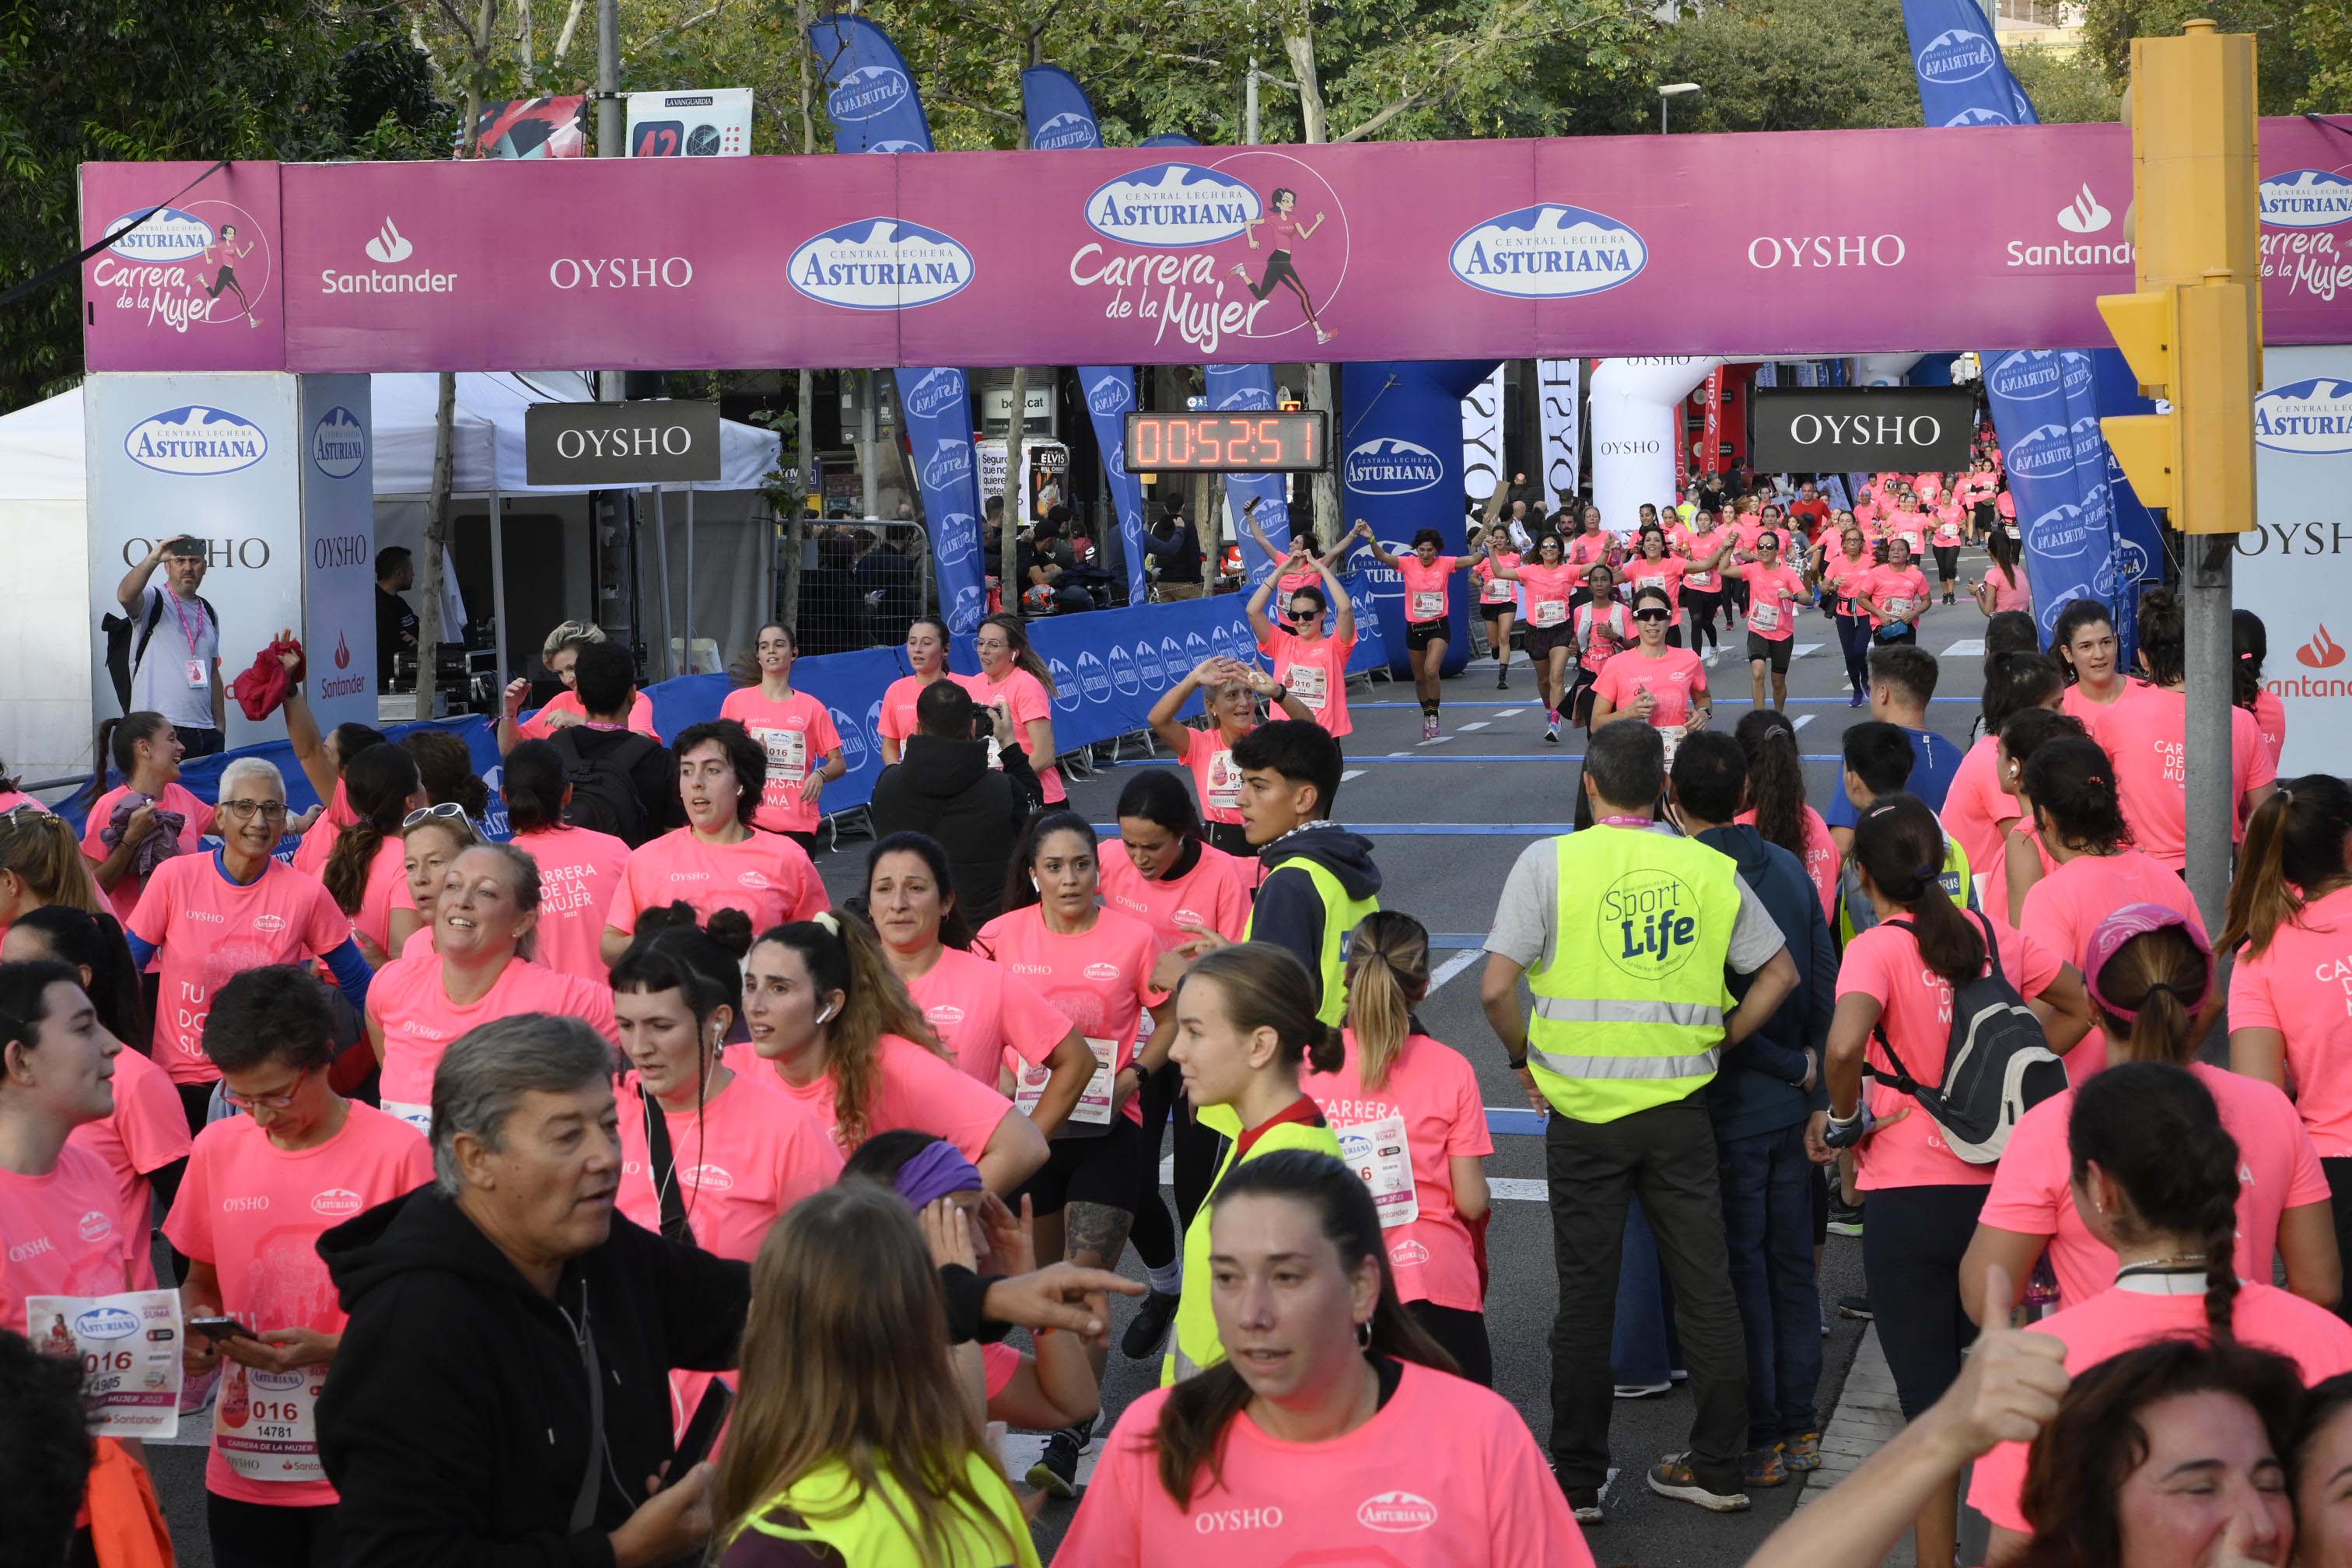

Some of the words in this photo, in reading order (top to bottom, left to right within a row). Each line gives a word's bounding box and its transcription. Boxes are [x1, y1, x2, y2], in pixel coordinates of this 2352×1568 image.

[1125, 192, 1181, 201] CENTRAL
[1187, 191, 1244, 200] LECHERA
[1099, 195, 1248, 227] ASTURIANA
[1496, 236, 1556, 246] CENTRAL
[1563, 236, 1626, 245] LECHERA
[1748, 234, 1906, 268] OYSHO
[2260, 232, 2334, 254] arrera
[830, 250, 888, 259] CENTRAL
[895, 249, 954, 258] LECHERA
[1465, 240, 1633, 275] ASTURIANA
[2007, 240, 2135, 268] Santand
[93, 258, 186, 287] Carrera
[549, 257, 694, 289] OYSHO
[802, 252, 961, 286] ASTURIANA
[1069, 243, 1216, 286] Carrera
[2278, 255, 2292, 277] la
[322, 269, 458, 294] Santander
[117, 289, 133, 309] de
[138, 289, 150, 309] la
[148, 285, 221, 333] Mujer
[1105, 288, 1132, 318] de
[1139, 287, 1158, 318] la
[1154, 280, 1270, 354] Mujer
[1002, 397, 1043, 409] bc.cat
[1790, 415, 1941, 446] OYSHO
[136, 432, 257, 458] ASTURIANA
[317, 432, 362, 462] ASTURIANA
[556, 425, 692, 459] OYSHO
[1137, 420, 1311, 464] 00:52:51
[1601, 440, 1660, 456] OYSHO
[1041, 453, 1065, 464] ELVIS
[1348, 461, 1436, 483] ASTURIANA
[123, 537, 271, 569] OHO
[314, 534, 367, 569] OYSHO
[322, 676, 365, 699] Santander
[769, 748, 788, 757] 016
[2165, 755, 2185, 768] DE
[670, 872, 709, 882] OYSHO
[541, 882, 562, 898] DE
[566, 880, 587, 894] LA
[542, 892, 593, 915] MUJER
[1115, 896, 1148, 913] OYSHO
[1606, 880, 1680, 922] Sport
[186, 909, 225, 923] OYSHO
[254, 919, 285, 929] ASTURIANA
[1171, 914, 1203, 924] ASTURIANA
[1622, 909, 1695, 961] Life
[1013, 964, 1052, 975] OYSHO
[1086, 968, 1118, 978] ASTURIANA
[181, 981, 205, 1003] TU
[927, 1011, 964, 1021] ASTURIANA
[224, 1195, 269, 1213] OYSHO
[316, 1199, 359, 1210] ASTURIANA
[1389, 1194, 1404, 1203] 2023
[1380, 1209, 1409, 1220] antander
[79, 1319, 136, 1333] ASTURIANA
[86, 1350, 133, 1374] 016
[254, 1370, 299, 1384] ASTURIANA
[114, 1414, 163, 1426] Santander
[253, 1401, 298, 1420] 016
[257, 1426, 292, 1438] 14781
[227, 1440, 259, 1451] CARRERA
[1195, 1506, 1283, 1535] OYSHO
[1364, 1507, 1433, 1524] ASTURIANA
